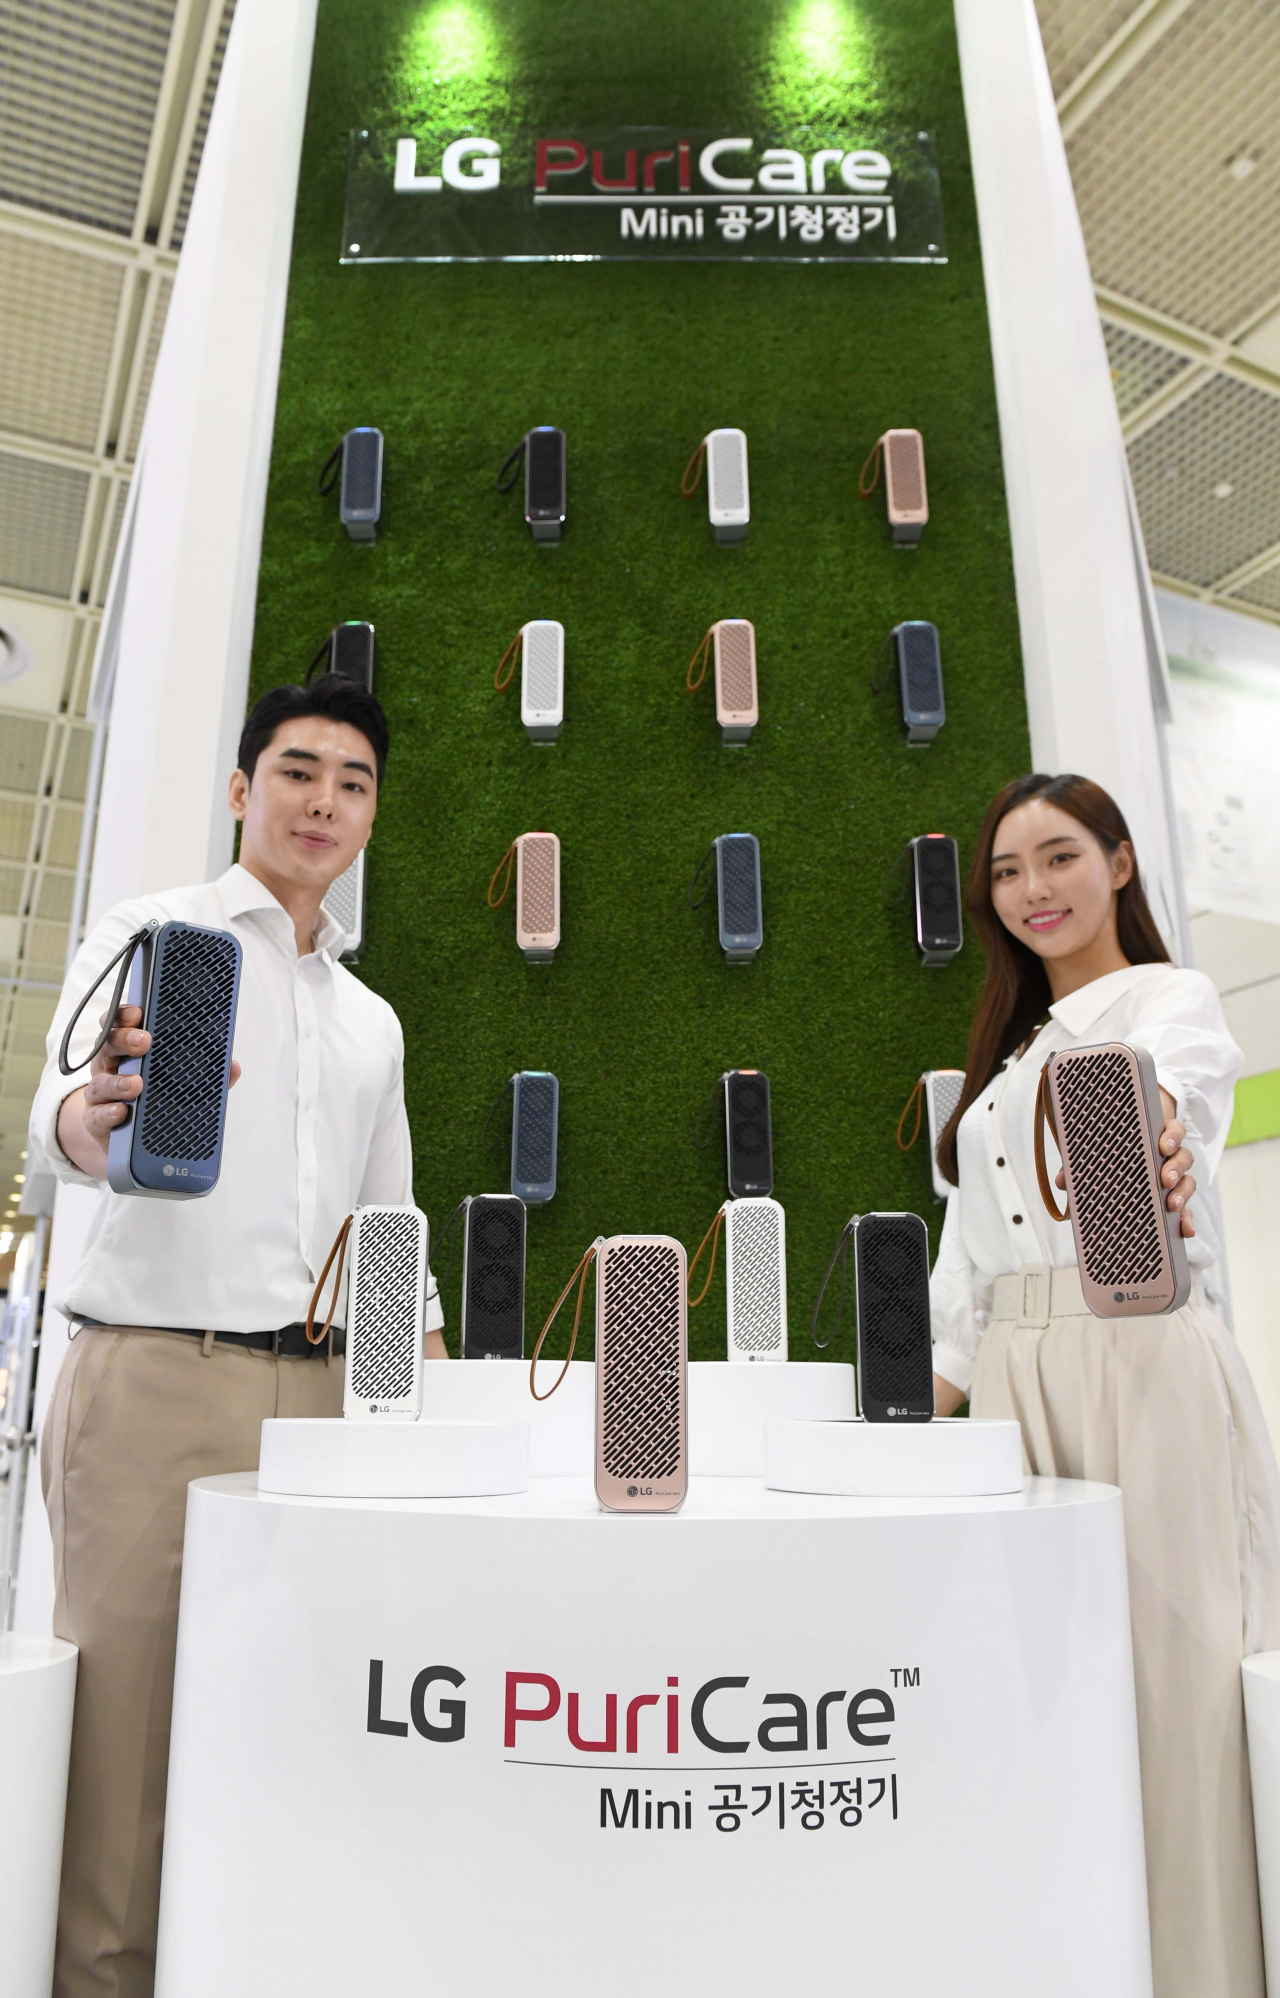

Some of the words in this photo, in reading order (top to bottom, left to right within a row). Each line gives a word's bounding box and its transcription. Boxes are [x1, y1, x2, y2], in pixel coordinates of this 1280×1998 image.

[393, 137, 500, 193] LG
[534, 137, 892, 193] PuriCare
[620, 208, 704, 239] Mini
[716, 205, 897, 241] 공기청정기
[176, 1167, 189, 1176] LG
[1126, 1292, 1140, 1300] LG
[640, 1487, 652, 1496] LG
[366, 1658, 467, 1743] LG
[600, 1787, 692, 1830] Mini
[708, 1773, 899, 1832] 공기청정기
